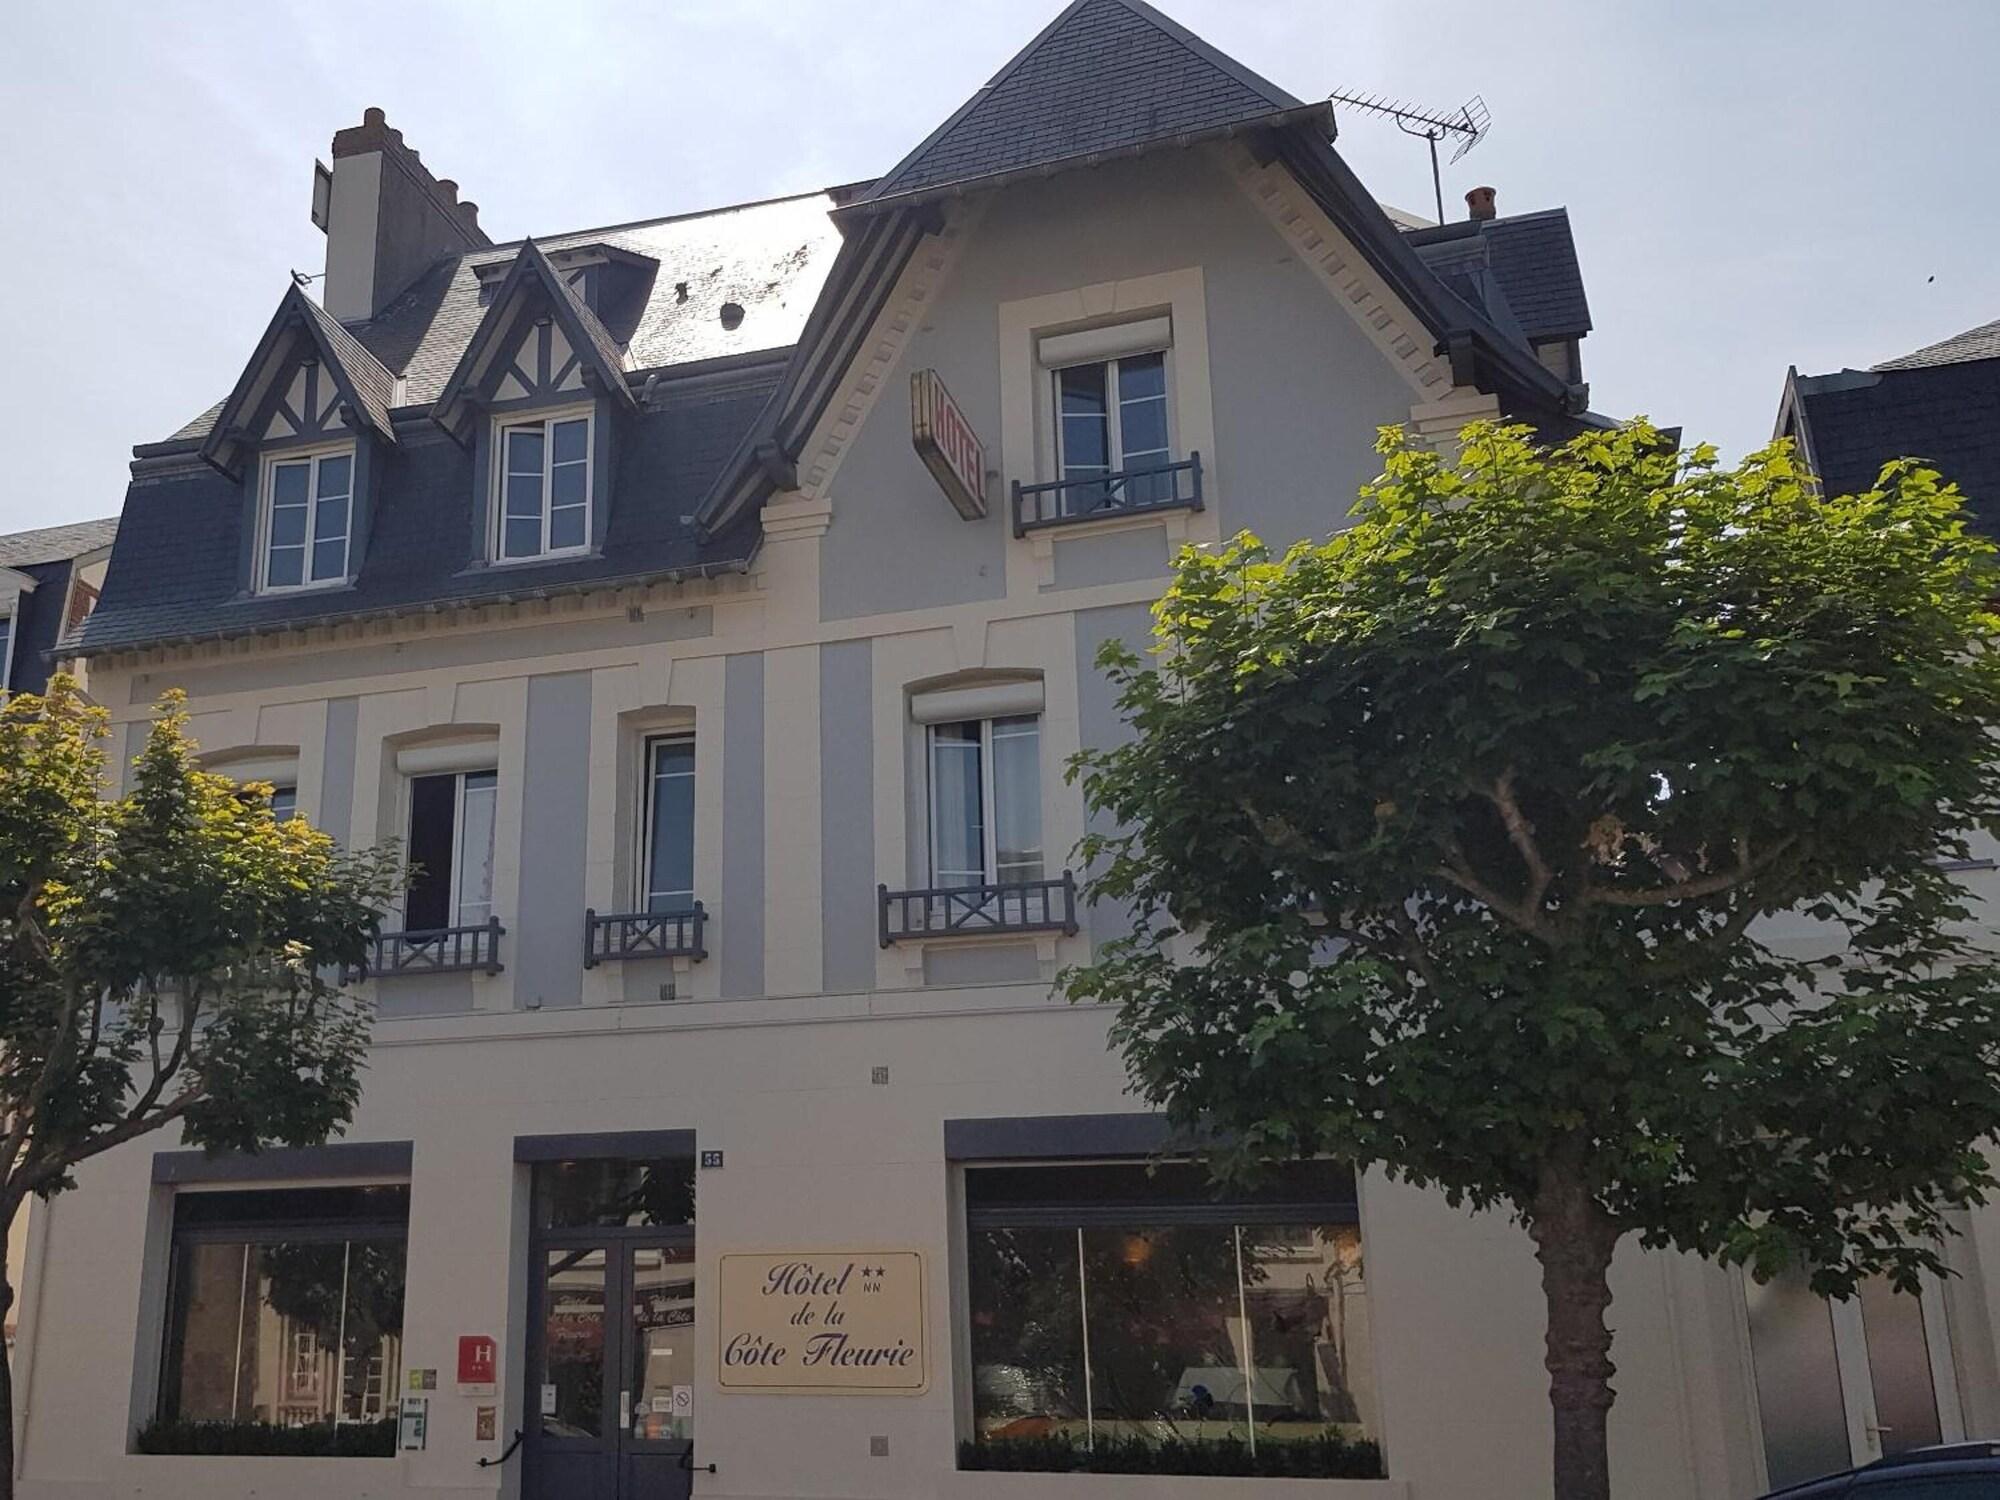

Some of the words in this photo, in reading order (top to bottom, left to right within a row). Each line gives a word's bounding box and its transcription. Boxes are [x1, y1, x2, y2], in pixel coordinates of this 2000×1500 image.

[934, 382, 984, 504] HOTEL
[704, 1153, 720, 1165] 55
[762, 1262, 855, 1296] Hôtel
[863, 1283, 881, 1293] NN
[790, 1301, 815, 1325] de
[824, 1301, 845, 1325] la
[475, 1345, 491, 1362] H
[724, 1333, 786, 1366] Côte
[802, 1333, 915, 1367] Fleurie
